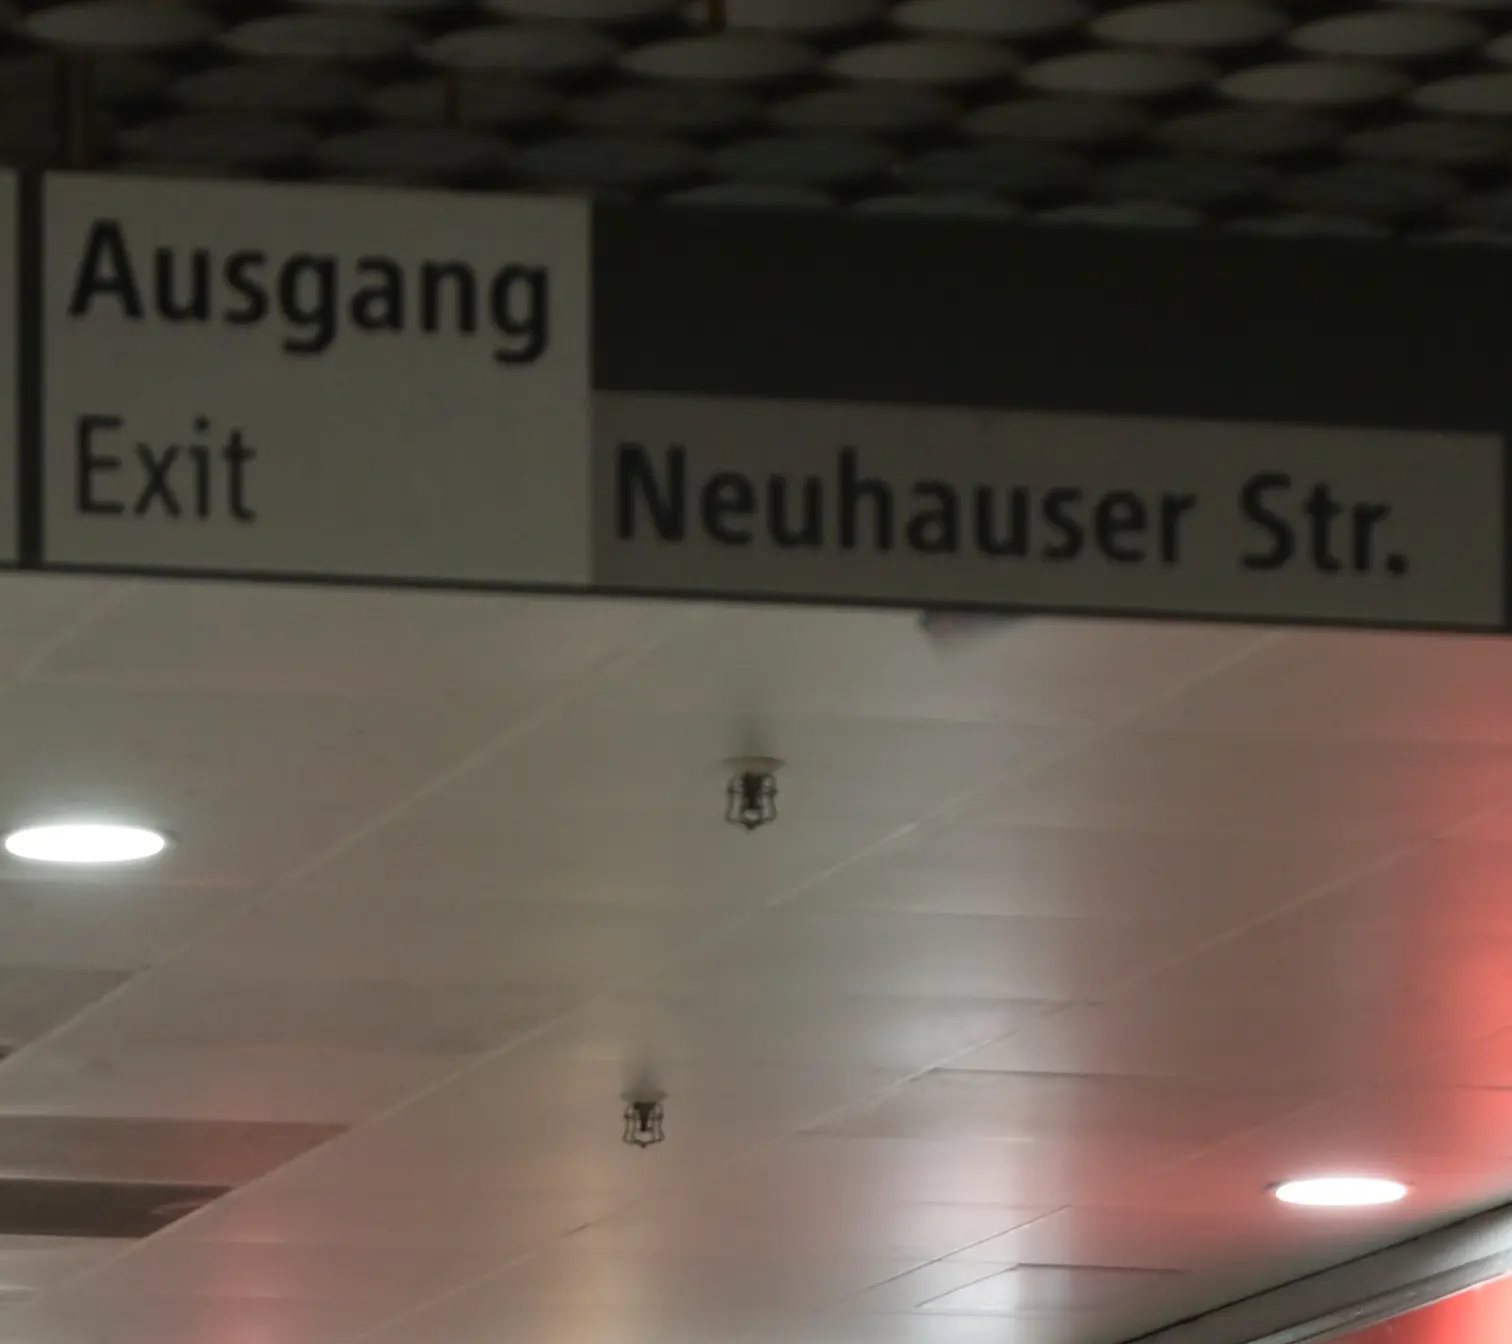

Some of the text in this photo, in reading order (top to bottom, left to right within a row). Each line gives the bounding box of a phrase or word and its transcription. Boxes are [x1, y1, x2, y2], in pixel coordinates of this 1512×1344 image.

[67, 217, 551, 366] Ausgang
[75, 412, 258, 524] Exit
[613, 441, 1410, 576] Neuhauser Str.
